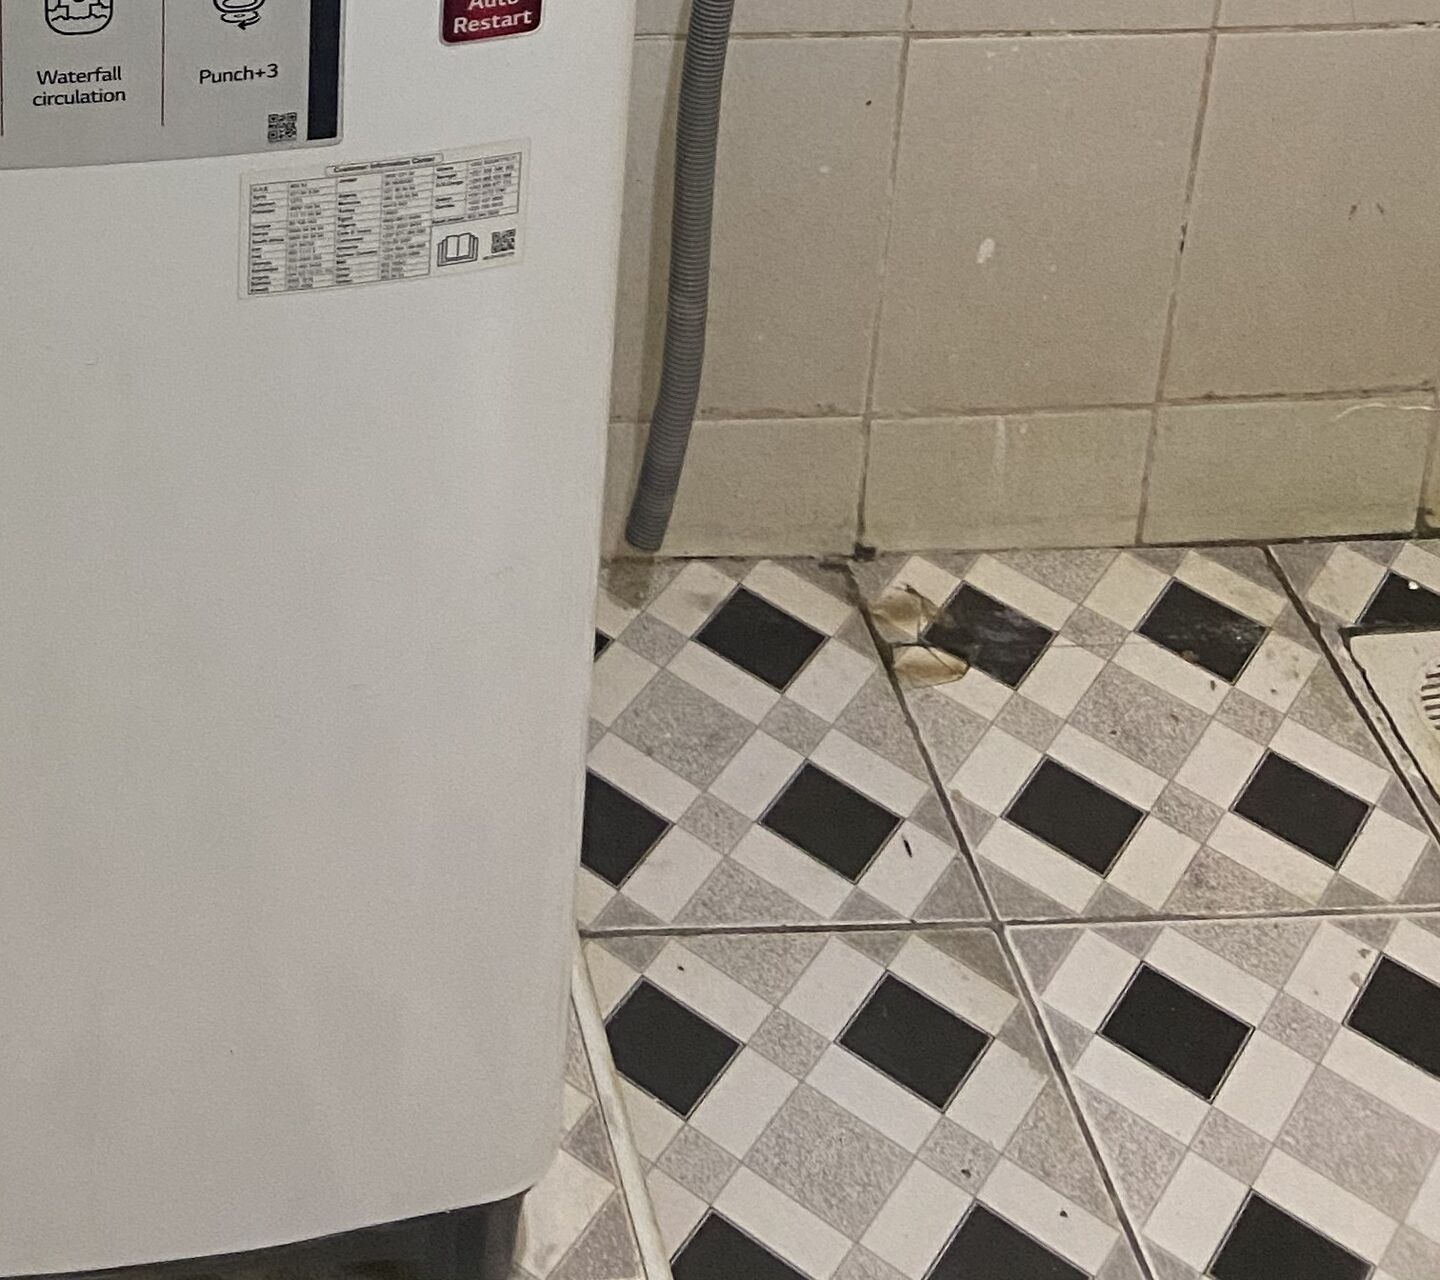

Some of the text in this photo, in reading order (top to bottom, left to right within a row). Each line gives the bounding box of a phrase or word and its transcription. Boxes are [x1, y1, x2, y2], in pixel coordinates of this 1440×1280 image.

[453, 10, 533, 34] Restart
[36, 66, 122, 85] Waterfall
[199, 63, 279, 84] Punch+3
[32, 88, 126, 106] circulation
